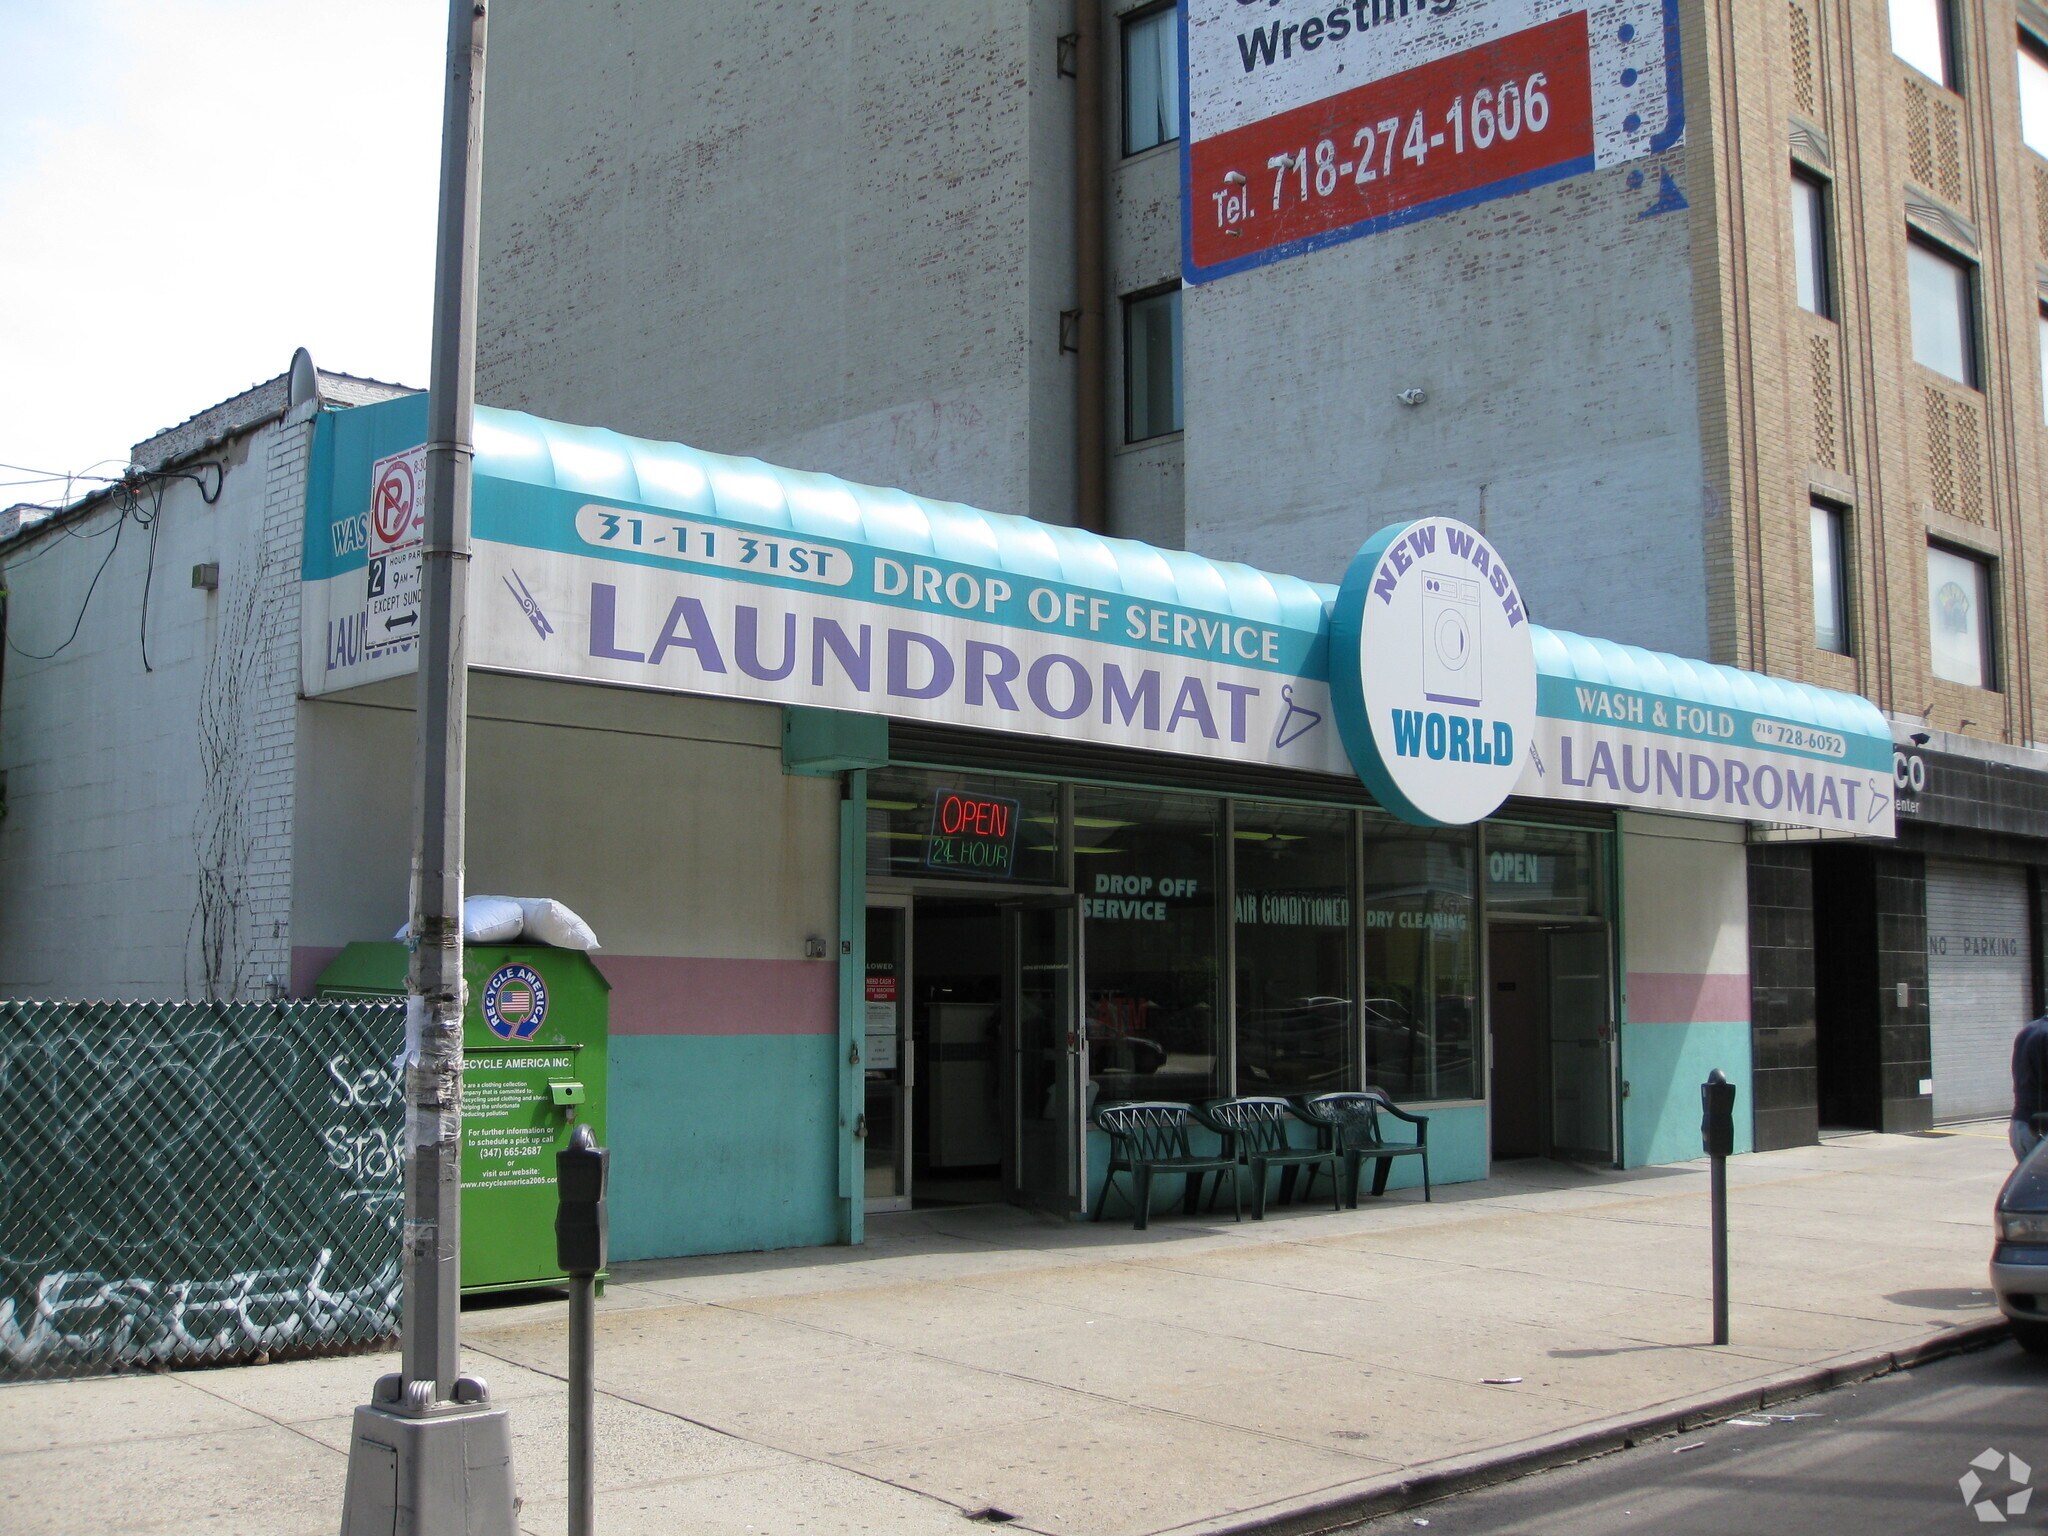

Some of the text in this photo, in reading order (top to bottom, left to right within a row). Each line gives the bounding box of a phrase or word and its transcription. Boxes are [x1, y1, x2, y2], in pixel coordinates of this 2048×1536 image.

[1212, 72, 1549, 229] Tel. 718-274-1606
[331, 511, 369, 558] WAS
[371, 560, 383, 593] 2
[389, 555, 407, 567] HOUR
[598, 512, 1280, 664] 31-11 31ST DROP OFF SERVICE
[1373, 525, 1524, 629] NEW WASH
[373, 589, 423, 614] EXCEPT SUND
[589, 582, 1260, 744] LAUNDROMAT
[1575, 687, 1842, 754] WASH & FOLD 718 728-6052
[1391, 708, 1514, 767] WORLD
[1561, 736, 1861, 821] LAUNDROMAT
[1893, 752, 1925, 792] CO
[942, 796, 1009, 837] OPEN
[1894, 799, 1920, 813] enter
[933, 838, 1009, 868] 24 HOUR
[1490, 851, 1538, 884] OPEN
[1095, 873, 1197, 898] DROP OFF
[1082, 900, 1166, 921] SERVICE
[1235, 894, 1349, 926] AIR CONDITIONED
[1367, 911, 1468, 930] DRY CLEANING
[1929, 937, 2017, 956] NO PARKING
[486, 967, 545, 1027] RECYCLE AMERICA
[462, 1057, 572, 1070] ECYCLE AMERICA INC.
[468, 1128, 480, 1137] For
[481, 1127, 505, 1136] further
[506, 1126, 545, 1135] information
[468, 1139, 475, 1147] to
[477, 1137, 508, 1146] schedule
[515, 1136, 530, 1146] pick
[541, 1135, 554, 1143] call
[480, 1146, 542, 1159] (347) 665-2687
[460, 1177, 558, 1189] www.recycleamerica2005.co
[482, 1168, 540, 1178] visit our website:
